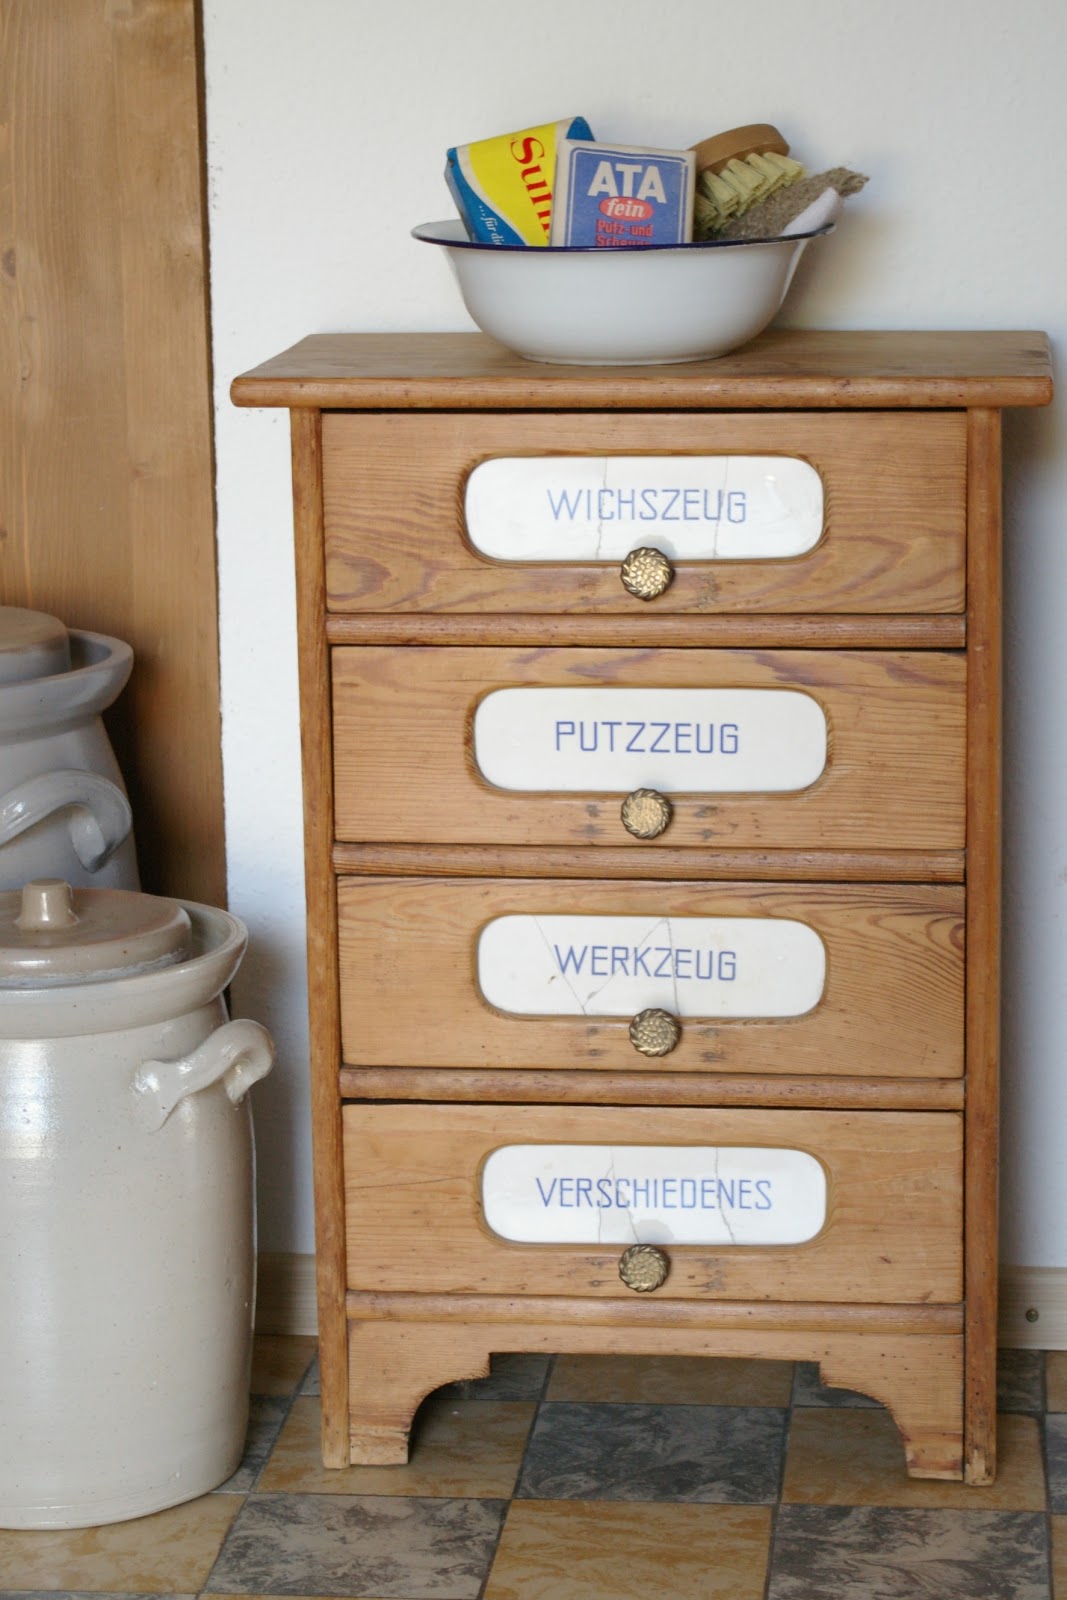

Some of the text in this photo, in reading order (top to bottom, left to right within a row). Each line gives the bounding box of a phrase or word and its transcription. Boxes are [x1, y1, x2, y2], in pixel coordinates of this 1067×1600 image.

[587, 160, 667, 204] ATA
[606, 198, 645, 218] fein
[630, 224, 653, 237] und
[547, 488, 747, 524] WICHSZEUG
[555, 721, 739, 754] PUTZZEUG
[554, 944, 737, 981] WERKZEUG
[535, 1177, 773, 1210] VERSCHIEDENES
